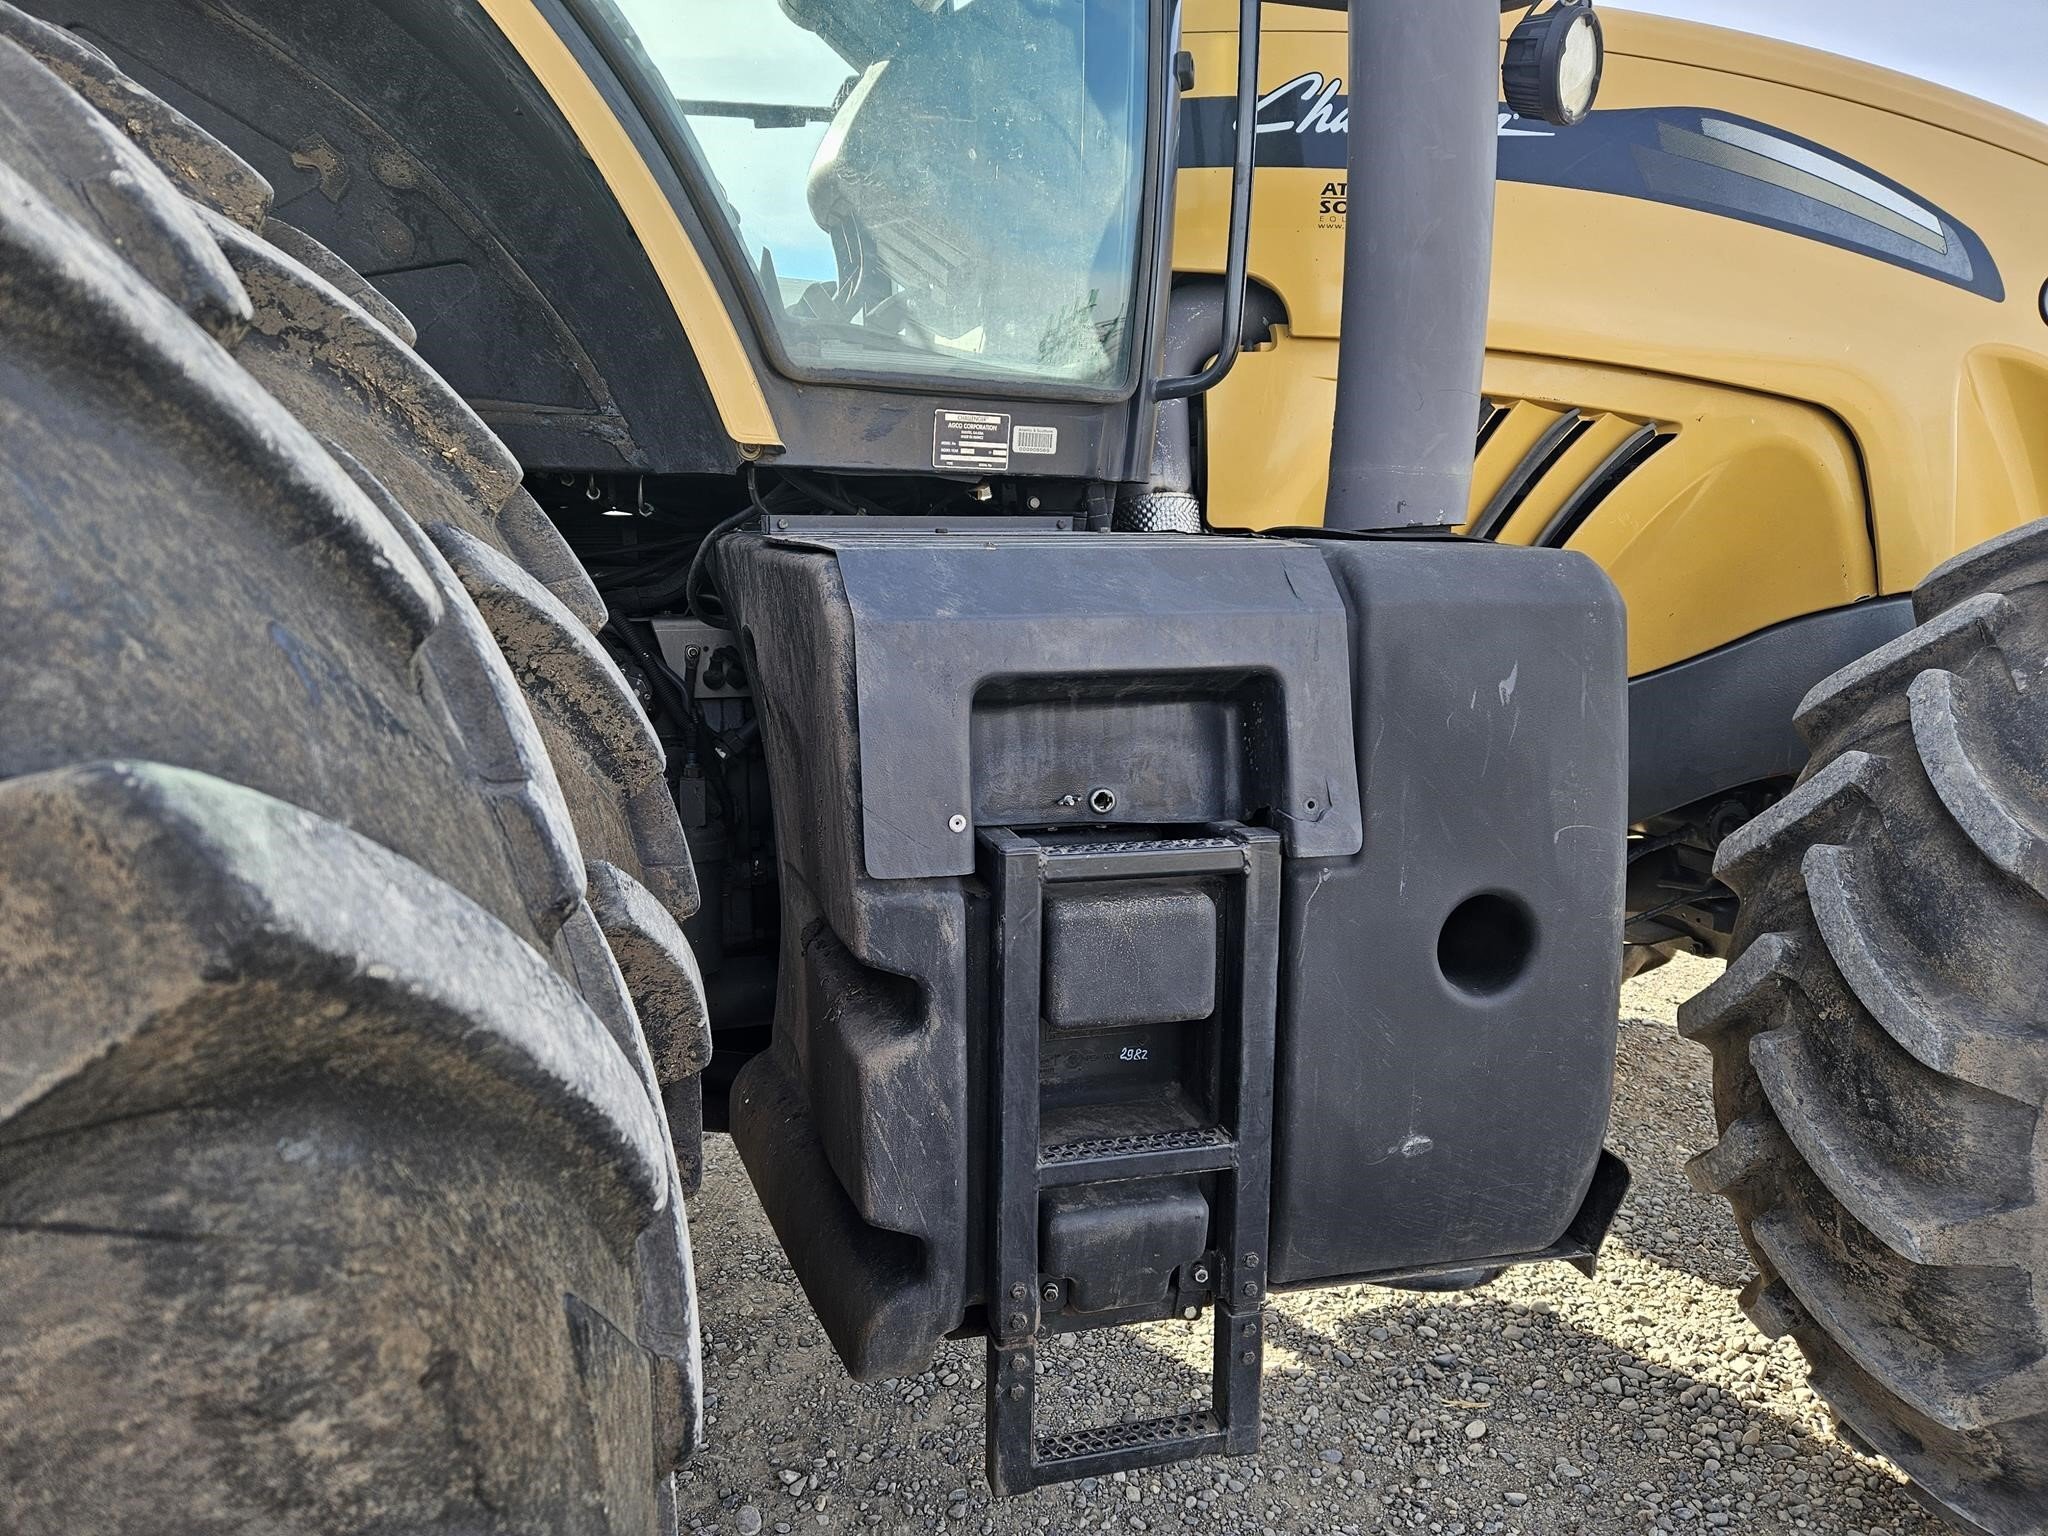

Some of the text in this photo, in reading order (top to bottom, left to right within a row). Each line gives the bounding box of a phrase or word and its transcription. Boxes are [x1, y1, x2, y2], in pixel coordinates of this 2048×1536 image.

[948, 422, 998, 431] AGCO CORPORATION
[1119, 1047, 1148, 1061] 2982
